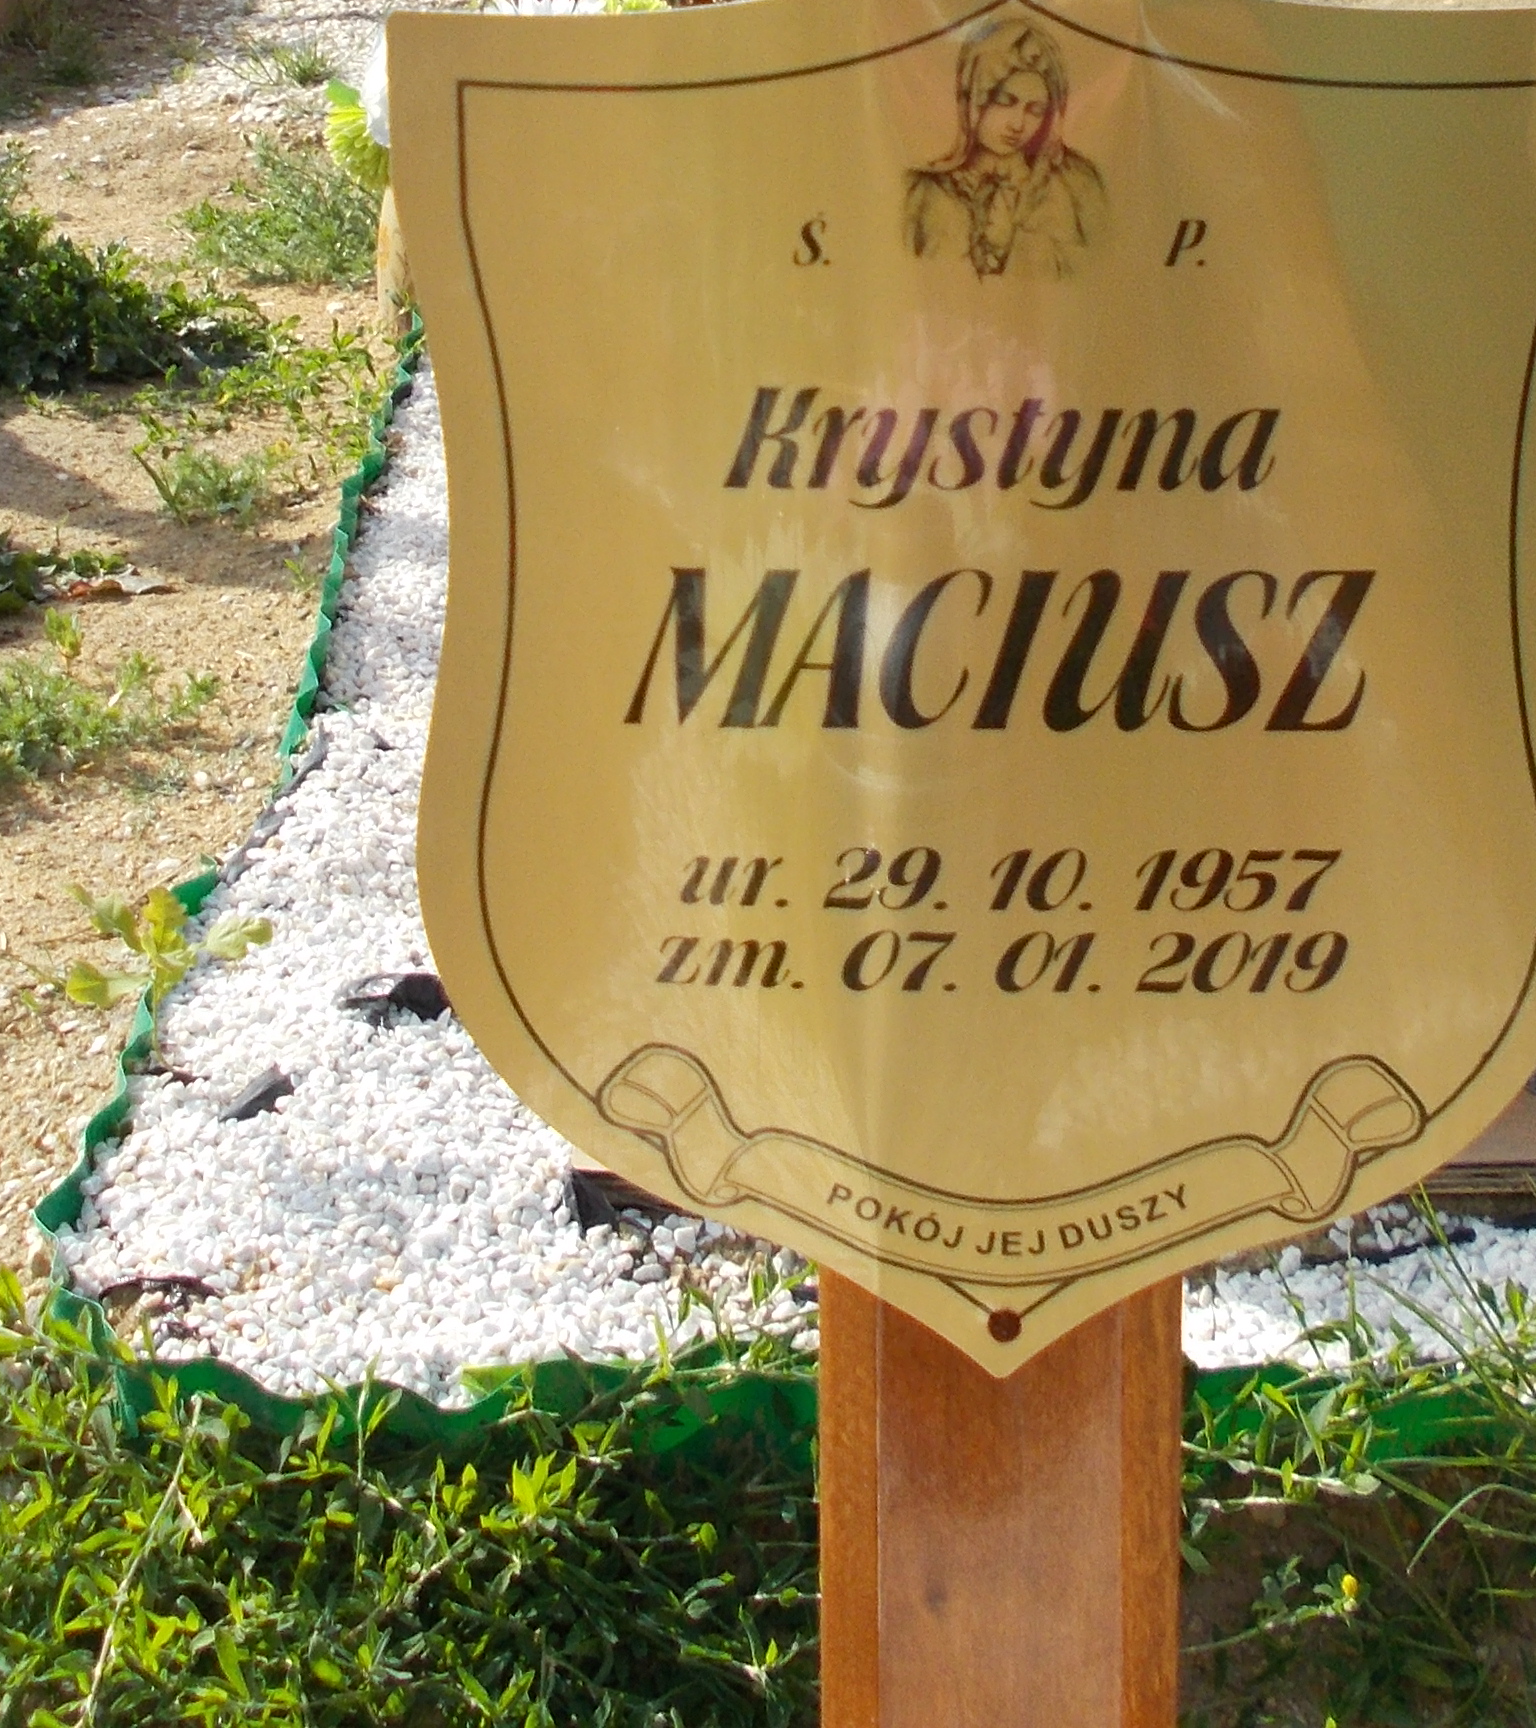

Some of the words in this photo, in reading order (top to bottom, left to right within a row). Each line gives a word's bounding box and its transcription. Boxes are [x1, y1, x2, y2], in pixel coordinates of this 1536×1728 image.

[794, 211, 832, 267] Ś.
[1165, 218, 1208, 267] P.
[724, 386, 1282, 509] Krystyna
[623, 566, 1377, 732] MACIUSZ
[679, 853, 791, 909] ur.
[823, 846, 948, 913] 29.
[989, 847, 1093, 913] 10.
[1133, 846, 1342, 913] 1957
[654, 933, 806, 992] zm.
[840, 930, 959, 993] 07.
[994, 930, 1102, 994] 01.
[1134, 929, 1349, 994] 2019
[825, 1182, 964, 1250] POKÓJ
[975, 1231, 1046, 1257] JEJ
[1059, 1183, 1190, 1250] DUSZY
